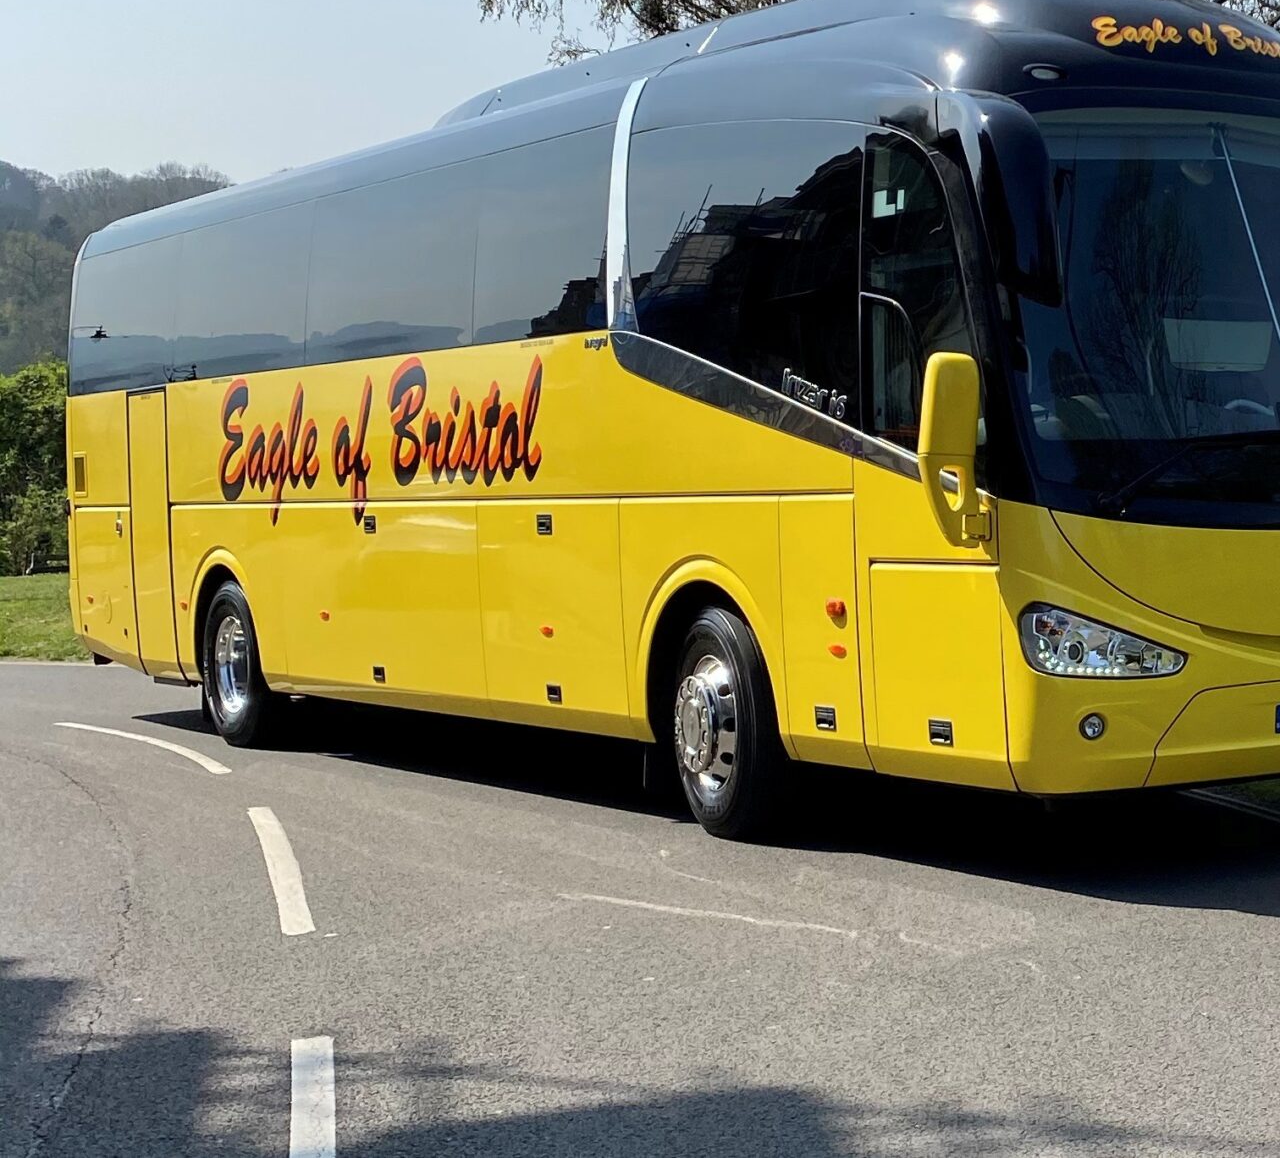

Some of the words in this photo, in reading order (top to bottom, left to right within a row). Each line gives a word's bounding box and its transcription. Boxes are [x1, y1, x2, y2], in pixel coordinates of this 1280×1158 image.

[1091, 16, 1182, 53] Eagle
[1187, 22, 1217, 56] of
[218, 378, 319, 526] Eagle
[331, 375, 371, 526] of
[387, 354, 542, 487] Bristol
